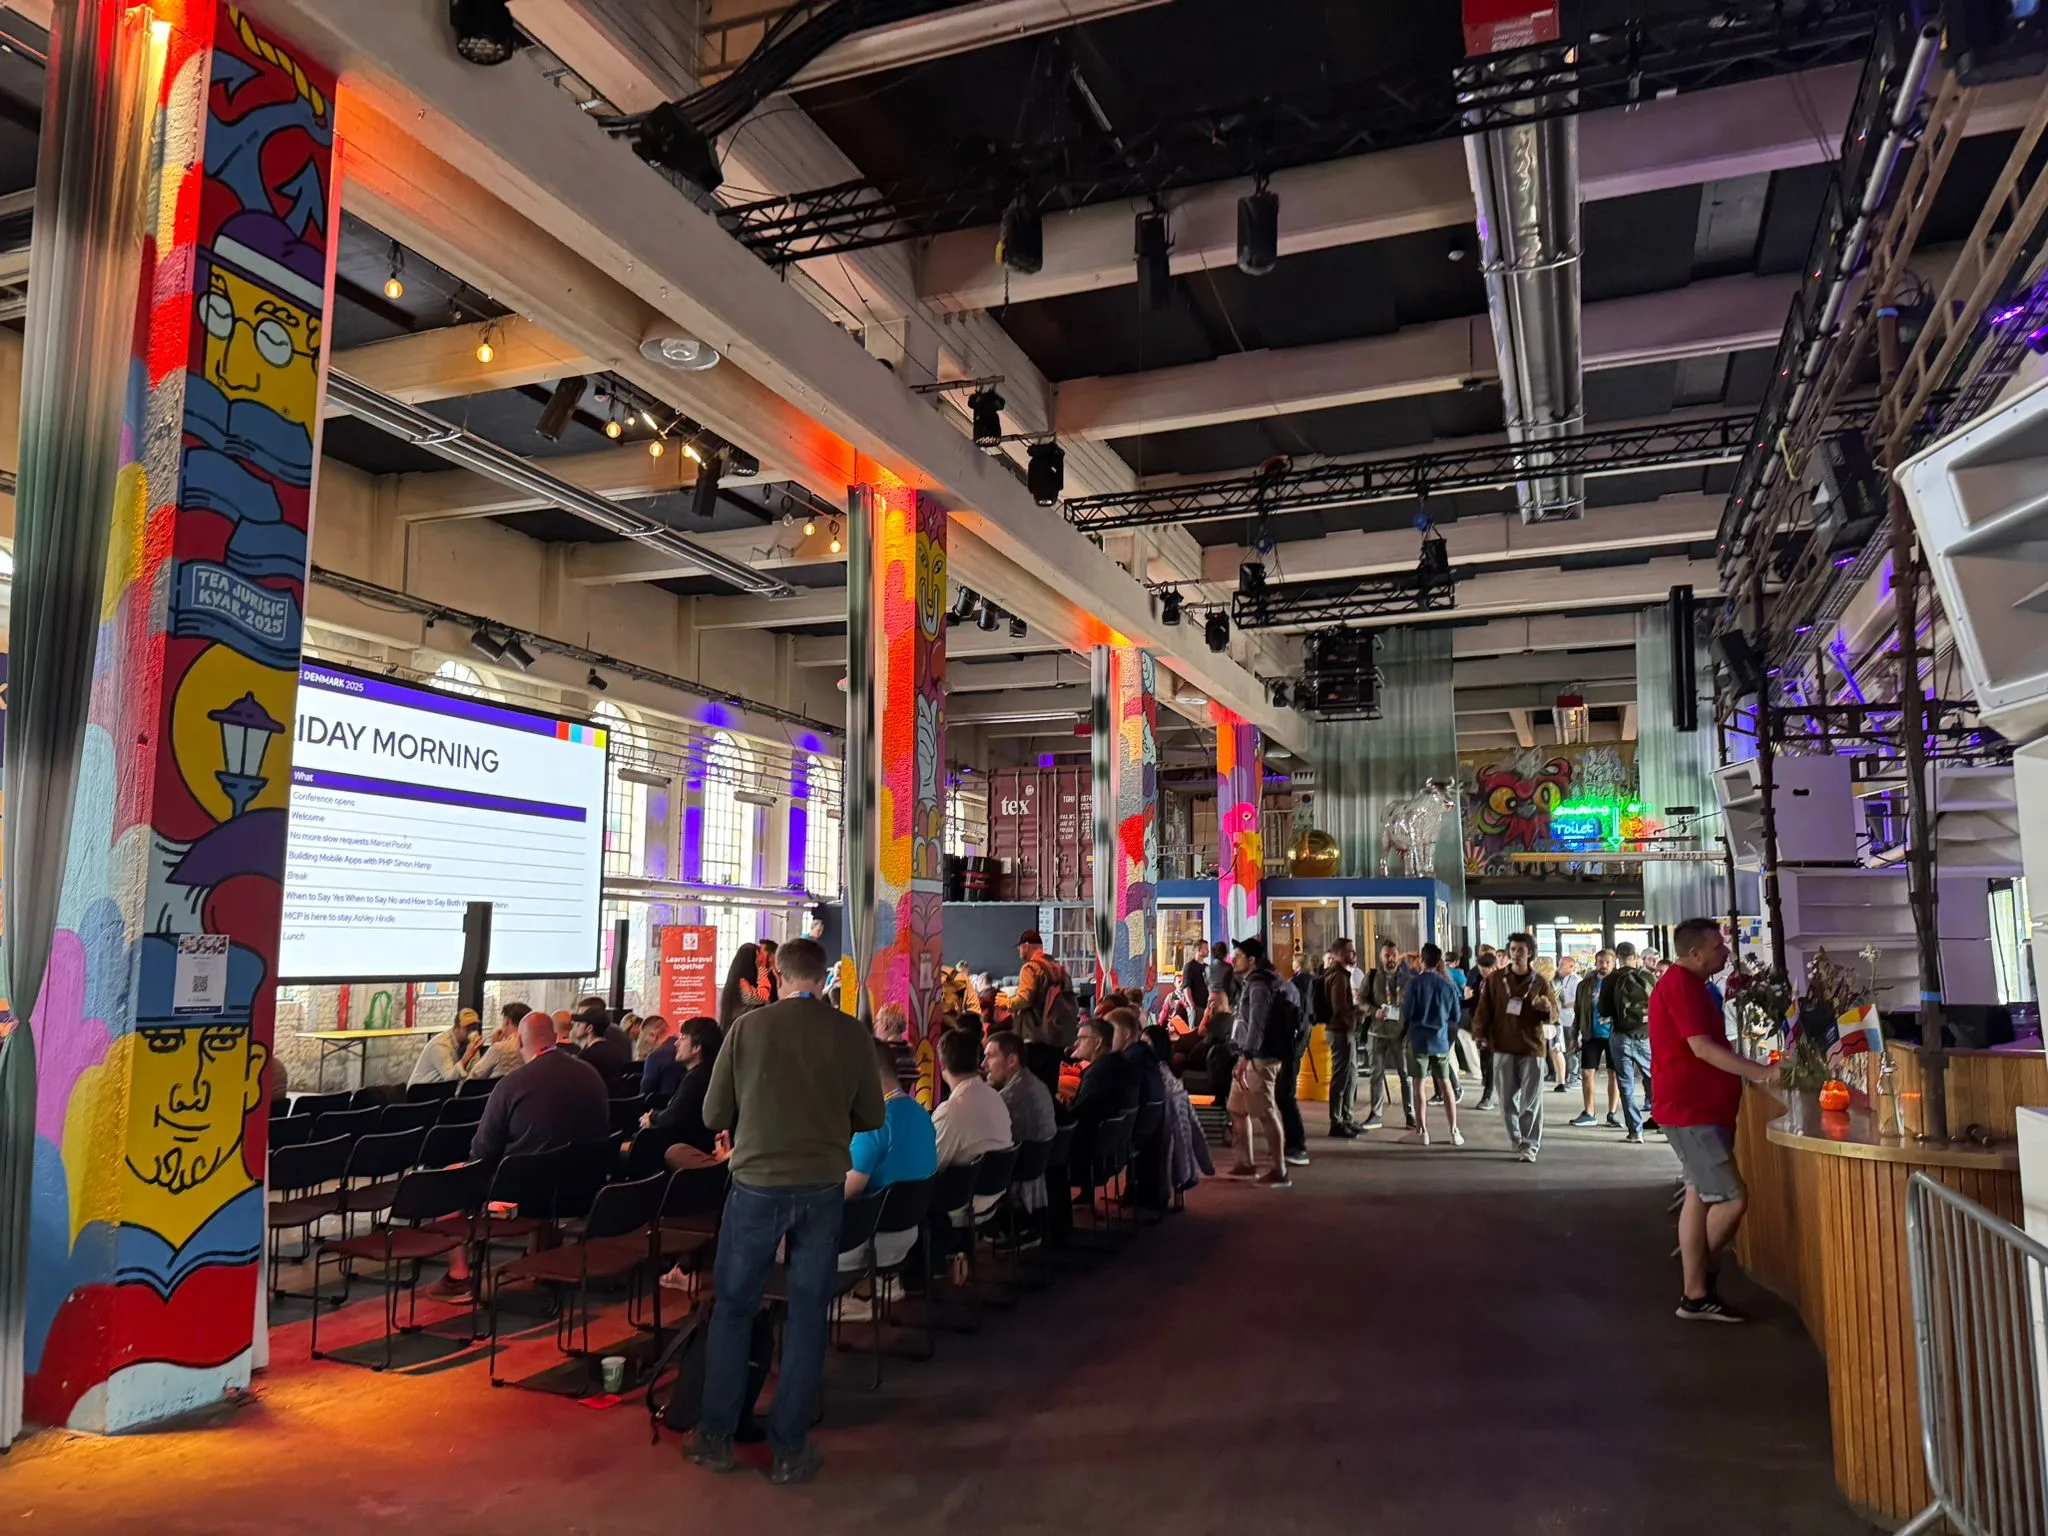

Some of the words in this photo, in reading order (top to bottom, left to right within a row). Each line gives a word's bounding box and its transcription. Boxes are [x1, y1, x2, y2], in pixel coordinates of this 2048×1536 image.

[197, 571, 230, 592] TEA
[245, 610, 284, 633] 2025
[303, 670, 344, 688] DENMARK
[345, 680, 364, 692] 2025
[298, 714, 367, 751] IDAY
[372, 727, 500, 773] MORNING
[293, 770, 314, 782] What
[292, 791, 333, 804] Conference
[333, 798, 355, 807] opens
[1001, 796, 1030, 816] tex
[291, 811, 325, 822] Welcome
[1553, 820, 1594, 834] Toilet
[289, 831, 301, 839] No
[302, 834, 321, 842] more
[339, 836, 369, 846] requests
[369, 839, 391, 848] Marcel
[288, 851, 318, 863] Building
[319, 853, 343, 863] Mobile
[344, 855, 362, 865] Apps
[363, 857, 377, 865] with
[378, 858, 393, 866] PHP
[393, 859, 413, 868] Simon
[287, 871, 308, 880] Break
[286, 891, 307, 901] When
[308, 892, 317, 901] to
[317, 893, 331, 904] Say
[332, 893, 345, 902] Yes
[345, 894, 366, 903] When
[366, 895, 374, 904] to
[374, 895, 387, 906] Say
[388, 896, 398, 904] No
[399, 897, 411, 905] and
[411, 897, 426, 905] How
[426, 898, 434, 906] to
[434, 898, 446, 908] Say
[446, 898, 461, 907] Both
[284, 912, 303, 920] MCP
[303, 912, 311, 920] is
[311, 912, 328, 921] here
[328, 913, 337, 921] to
[337, 914, 353, 924] stay
[1619, 909, 1641, 918] EXIT
[282, 932, 305, 941] Lunch
[687, 955, 713, 963] Laravel
[673, 963, 705, 971] together
